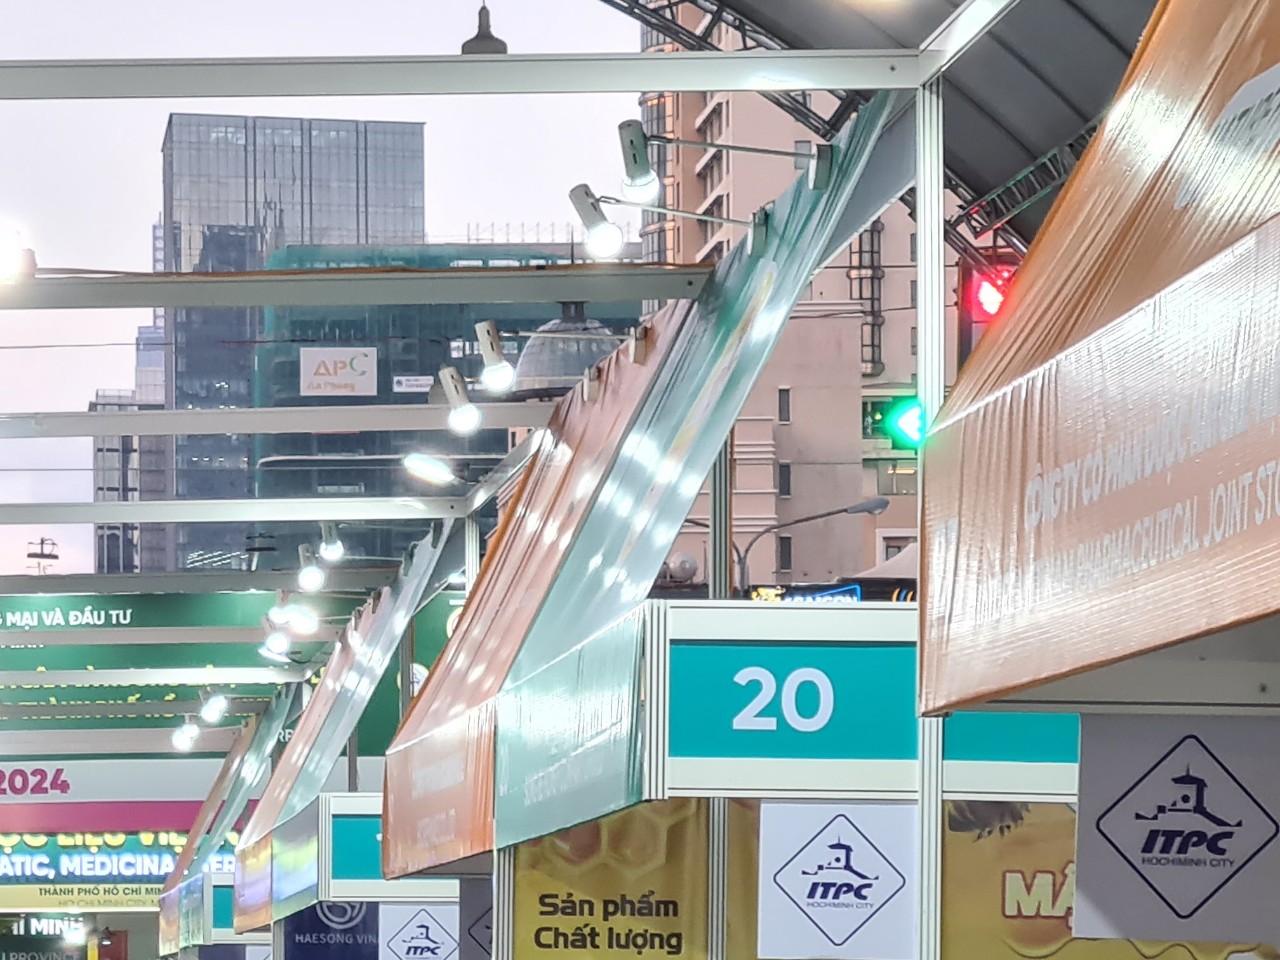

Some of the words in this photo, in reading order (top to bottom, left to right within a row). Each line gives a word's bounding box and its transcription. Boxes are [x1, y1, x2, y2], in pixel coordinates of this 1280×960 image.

[313, 352, 369, 377] APC
[1203, 472, 1253, 548] JOINT
[6, 609, 39, 631] MẠI
[41, 607, 65, 626] VÀ
[108, 608, 133, 625] TƯ
[732, 667, 834, 732] 20
[1141, 830, 1236, 856] ITPC
[60, 854, 177, 876] MEDICINA
[1209, 857, 1236, 868] CITY
[806, 882, 874, 901] ITPC
[538, 893, 594, 919] Sản
[602, 889, 680, 924] phẩm
[856, 901, 874, 909] CITY
[30, 918, 85, 936] MINH
[295, 933, 353, 945] HAESONG
[357, 933, 379, 945] VIN
[405, 945, 441, 956] ITPC
[534, 924, 600, 950] Chất
[607, 926, 683, 956] lượng
